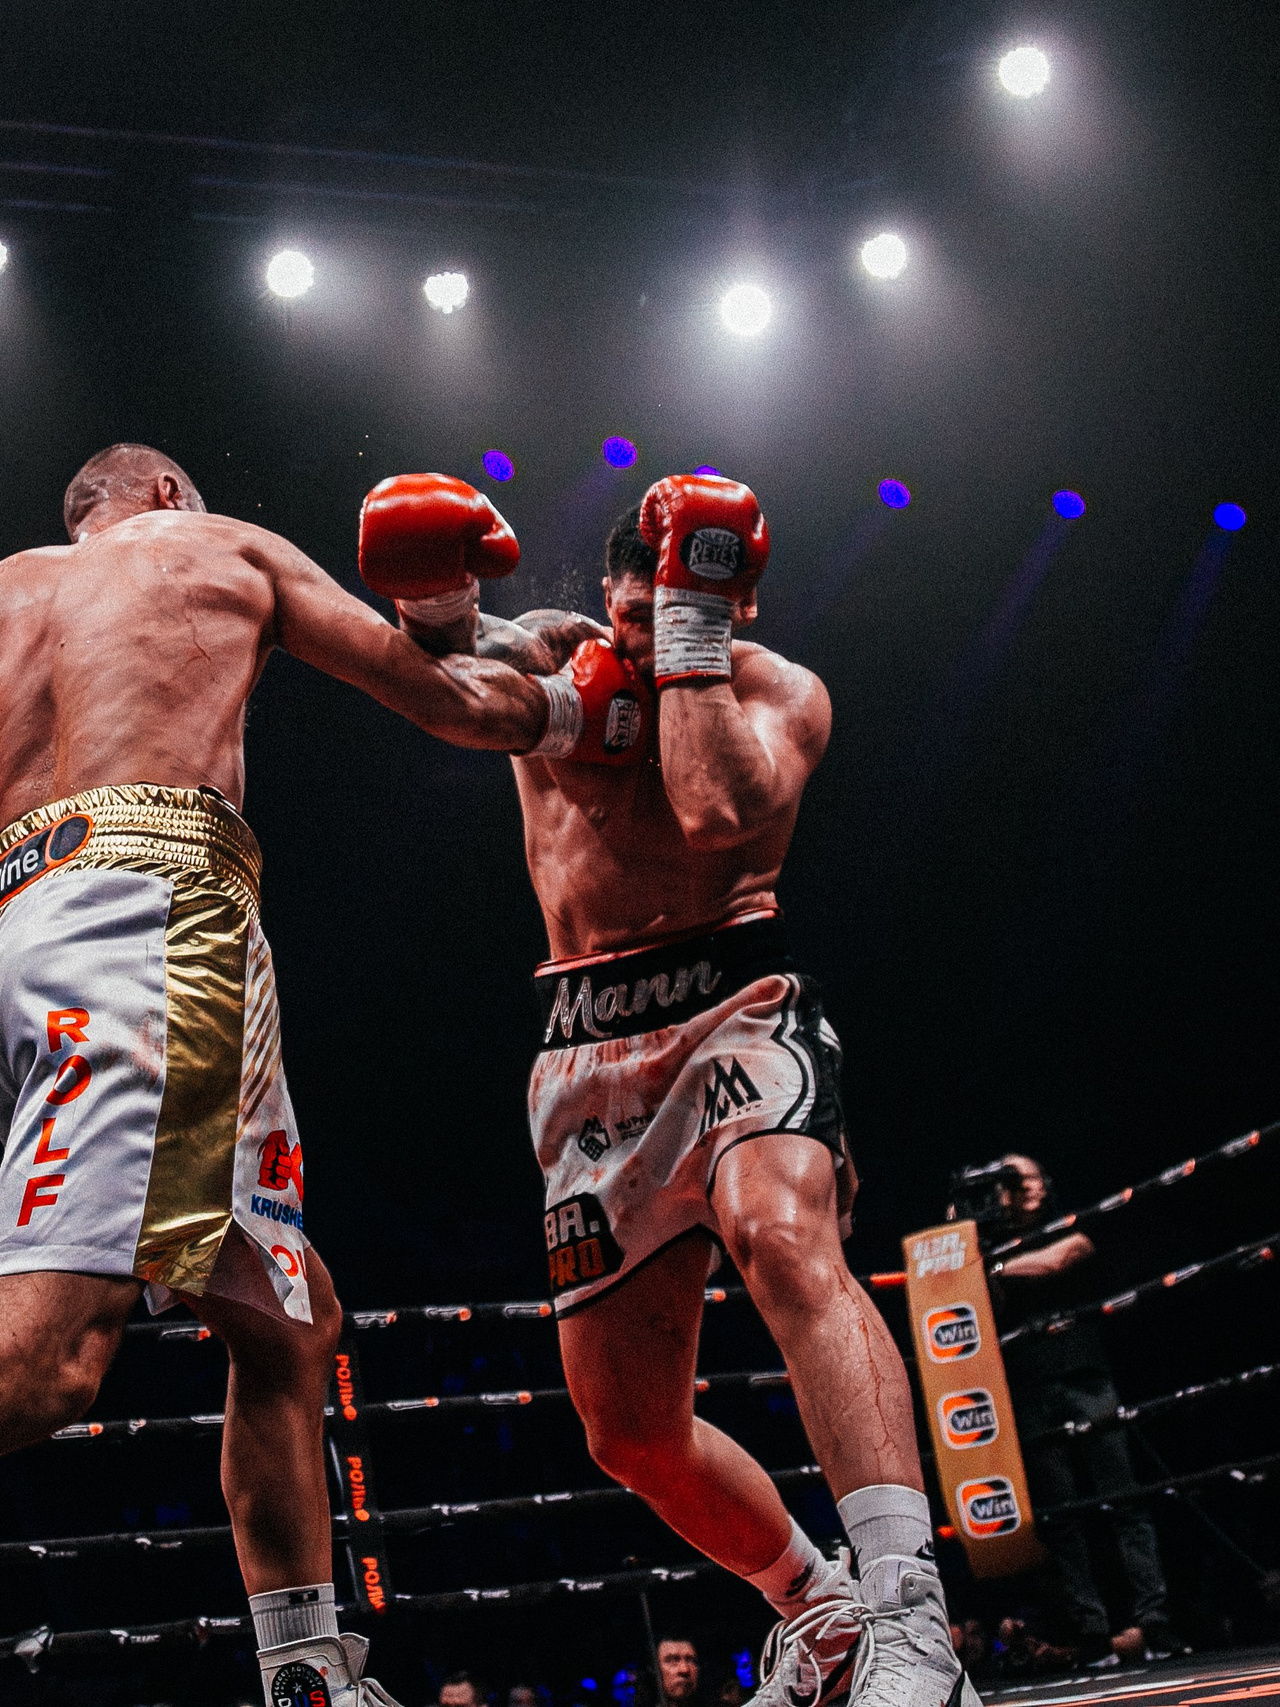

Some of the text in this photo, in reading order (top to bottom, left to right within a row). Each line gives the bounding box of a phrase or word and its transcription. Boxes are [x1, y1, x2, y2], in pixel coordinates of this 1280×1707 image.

[689, 538, 739, 569] REYES
[543, 961, 722, 1044] Mann
[16, 1007, 92, 1228] ROLF
[938, 1322, 977, 1343] Win
[953, 1410, 994, 1430] Win
[973, 1498, 1017, 1517] Win
